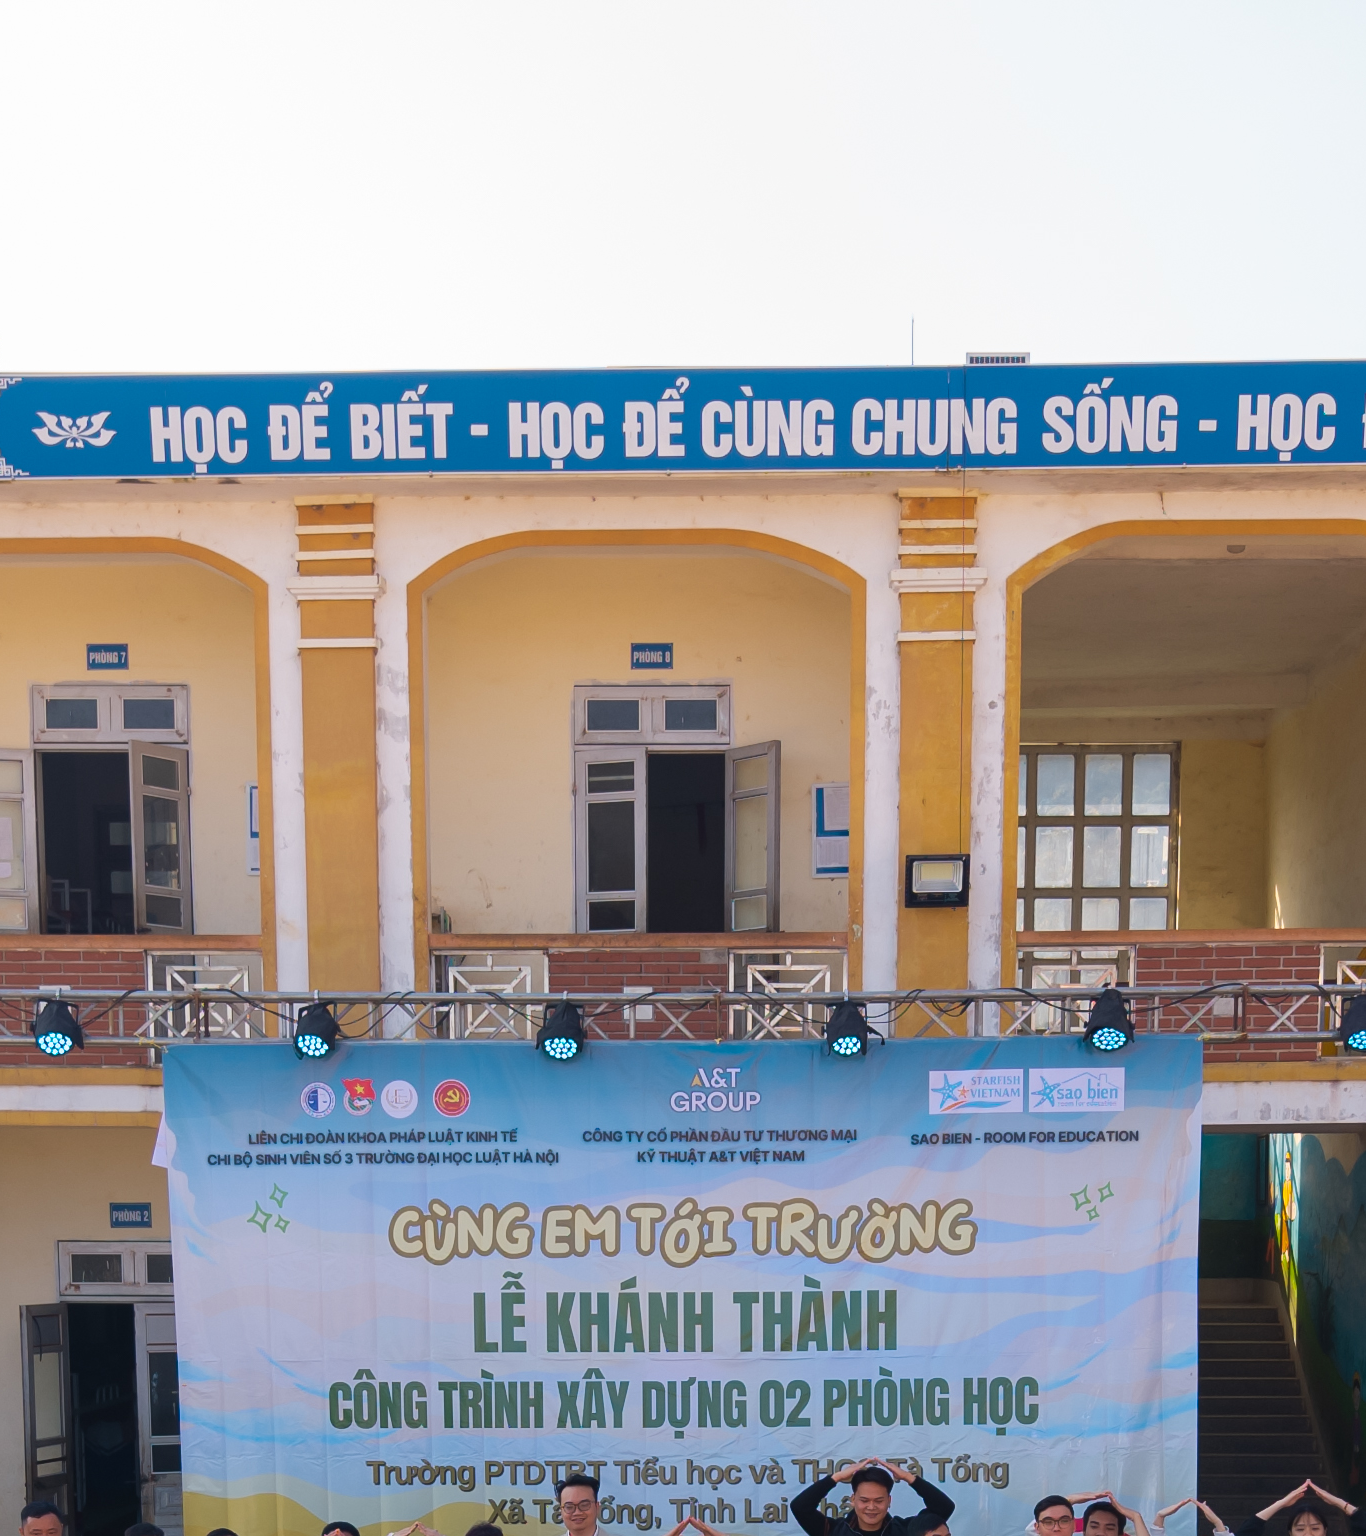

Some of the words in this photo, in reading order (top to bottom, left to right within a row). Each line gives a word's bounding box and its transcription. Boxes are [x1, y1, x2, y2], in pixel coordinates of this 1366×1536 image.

[150, 405, 247, 474] HỌC
[268, 381, 333, 461] ĐỂ
[351, 383, 453, 460] BIẾT
[509, 402, 604, 469] HỌC
[624, 376, 685, 458] ĐỂ
[702, 386, 834, 456] CÙNG
[851, 396, 1017, 456] CHUNG
[1042, 377, 1178, 454] SỐNG
[1237, 392, 1336, 461] HỌC
[89, 650, 119, 664] PHÒNG
[120, 652, 126, 664] 7
[633, 649, 663, 663] PHÒNG
[972, 1076, 1020, 1086] STARFISH
[1057, 1086, 1084, 1100] sao
[1087, 1079, 1118, 1099] bien
[670, 1092, 761, 1112] GROUP
[971, 1087, 1020, 1098] VIETNAM
[248, 1129, 278, 1145] LIÊN
[280, 1132, 303, 1145] CHI
[305, 1129, 345, 1145] ĐOÀN
[348, 1132, 387, 1144] KHOA
[390, 1129, 426, 1144] PHÁP
[428, 1129, 464, 1146] LUẬT
[466, 1131, 498, 1143] KINH
[500, 1127, 518, 1143] TẾ
[583, 1128, 623, 1144] CÔNG
[626, 1131, 646, 1143] TY
[670, 1126, 708, 1143] PHẦN
[710, 1127, 741, 1143] ĐẦU
[744, 1129, 764, 1143] TƯ
[766, 1129, 828, 1142] THƯƠNG
[831, 1129, 857, 1144] MẠI
[911, 1133, 940, 1146] SAO
[942, 1132, 972, 1145] BIEN
[983, 1131, 1025, 1144] ROOM
[1029, 1131, 1055, 1144] FOR
[1058, 1130, 1139, 1143] EDUCATION
[207, 1154, 232, 1166] CHI
[234, 1151, 251, 1169] BỘ
[253, 1153, 286, 1166] SINH
[289, 1150, 320, 1166] VIÊN
[323, 1148, 342, 1165] SỐ
[344, 1153, 353, 1165] 3
[356, 1150, 415, 1165] TRƯỜNG
[417, 1152, 439, 1167] ĐẠI
[442, 1152, 473, 1168] HỌC
[475, 1149, 510, 1166] LUẬT
[513, 1149, 533, 1164] HÀ
[536, 1149, 559, 1166] NỘI
[638, 1148, 655, 1164] KỸ
[658, 1147, 707, 1165] THUẬT
[709, 1150, 737, 1162] A&T
[739, 1147, 770, 1164] VIỆT
[772, 1149, 805, 1162] NAM
[112, 1208, 141, 1222] PHÒNG
[143, 1211, 149, 1222] 2
[389, 1198, 534, 1265] CÙNG
[540, 1202, 621, 1258] EM
[627, 1196, 737, 1268] TỚI
[744, 1197, 978, 1264] TRƯỜNG
[473, 1272, 527, 1354] LỄ
[546, 1276, 713, 1354] KHÁNH
[732, 1273, 898, 1353] THÀNH
[328, 1369, 428, 1431] CÔNG
[438, 1370, 544, 1430] TRÌNH
[556, 1367, 629, 1430] XÂY
[641, 1376, 748, 1441] DỰNG
[823, 1366, 954, 1428] PHÒNG
[962, 1376, 1040, 1438] HỌC
[366, 1458, 476, 1492] Trường
[613, 1456, 677, 1486] Tiểu
[686, 1458, 741, 1490] học
[749, 1458, 785, 1484] và
[931, 1454, 1009, 1489] Tổng
[488, 1498, 527, 1525] Xã
[596, 1493, 661, 1531] ổng,
[669, 1497, 742, 1524] Tỉnh
[744, 1497, 788, 1524] Lai
